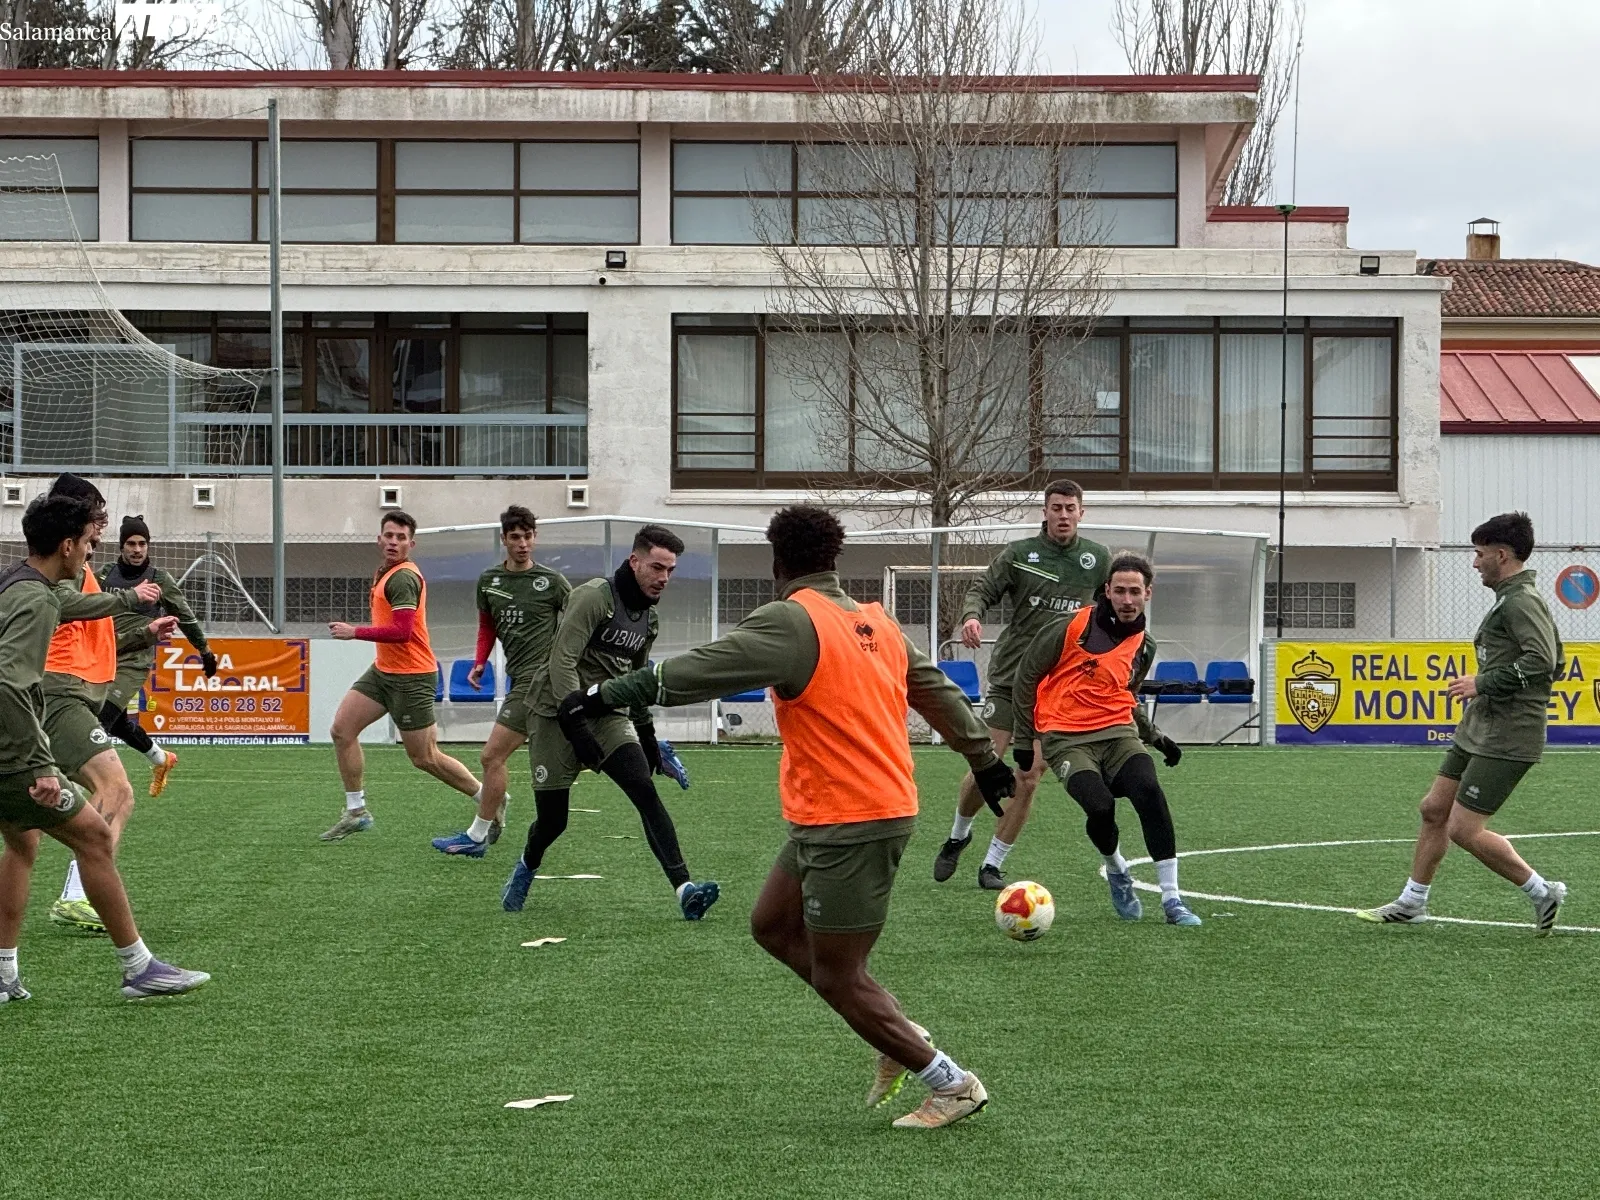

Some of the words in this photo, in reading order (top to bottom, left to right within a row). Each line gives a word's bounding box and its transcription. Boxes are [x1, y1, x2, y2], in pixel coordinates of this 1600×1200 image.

[1050, 597, 1081, 611] TAPAS
[1352, 654, 1418, 681] REAL
[175, 670, 284, 691] LABORAL
[174, 697, 204, 712] 652
[210, 697, 230, 712] 86
[236, 697, 256, 712] 28
[262, 697, 283, 712] 52
[253, 724, 295, 732] (SALAMANCA)
[200, 737, 211, 745] DE
[212, 735, 265, 745] PROTECCIÓN
[267, 736, 304, 745] LABORAL
[1427, 729, 1454, 742] Des
